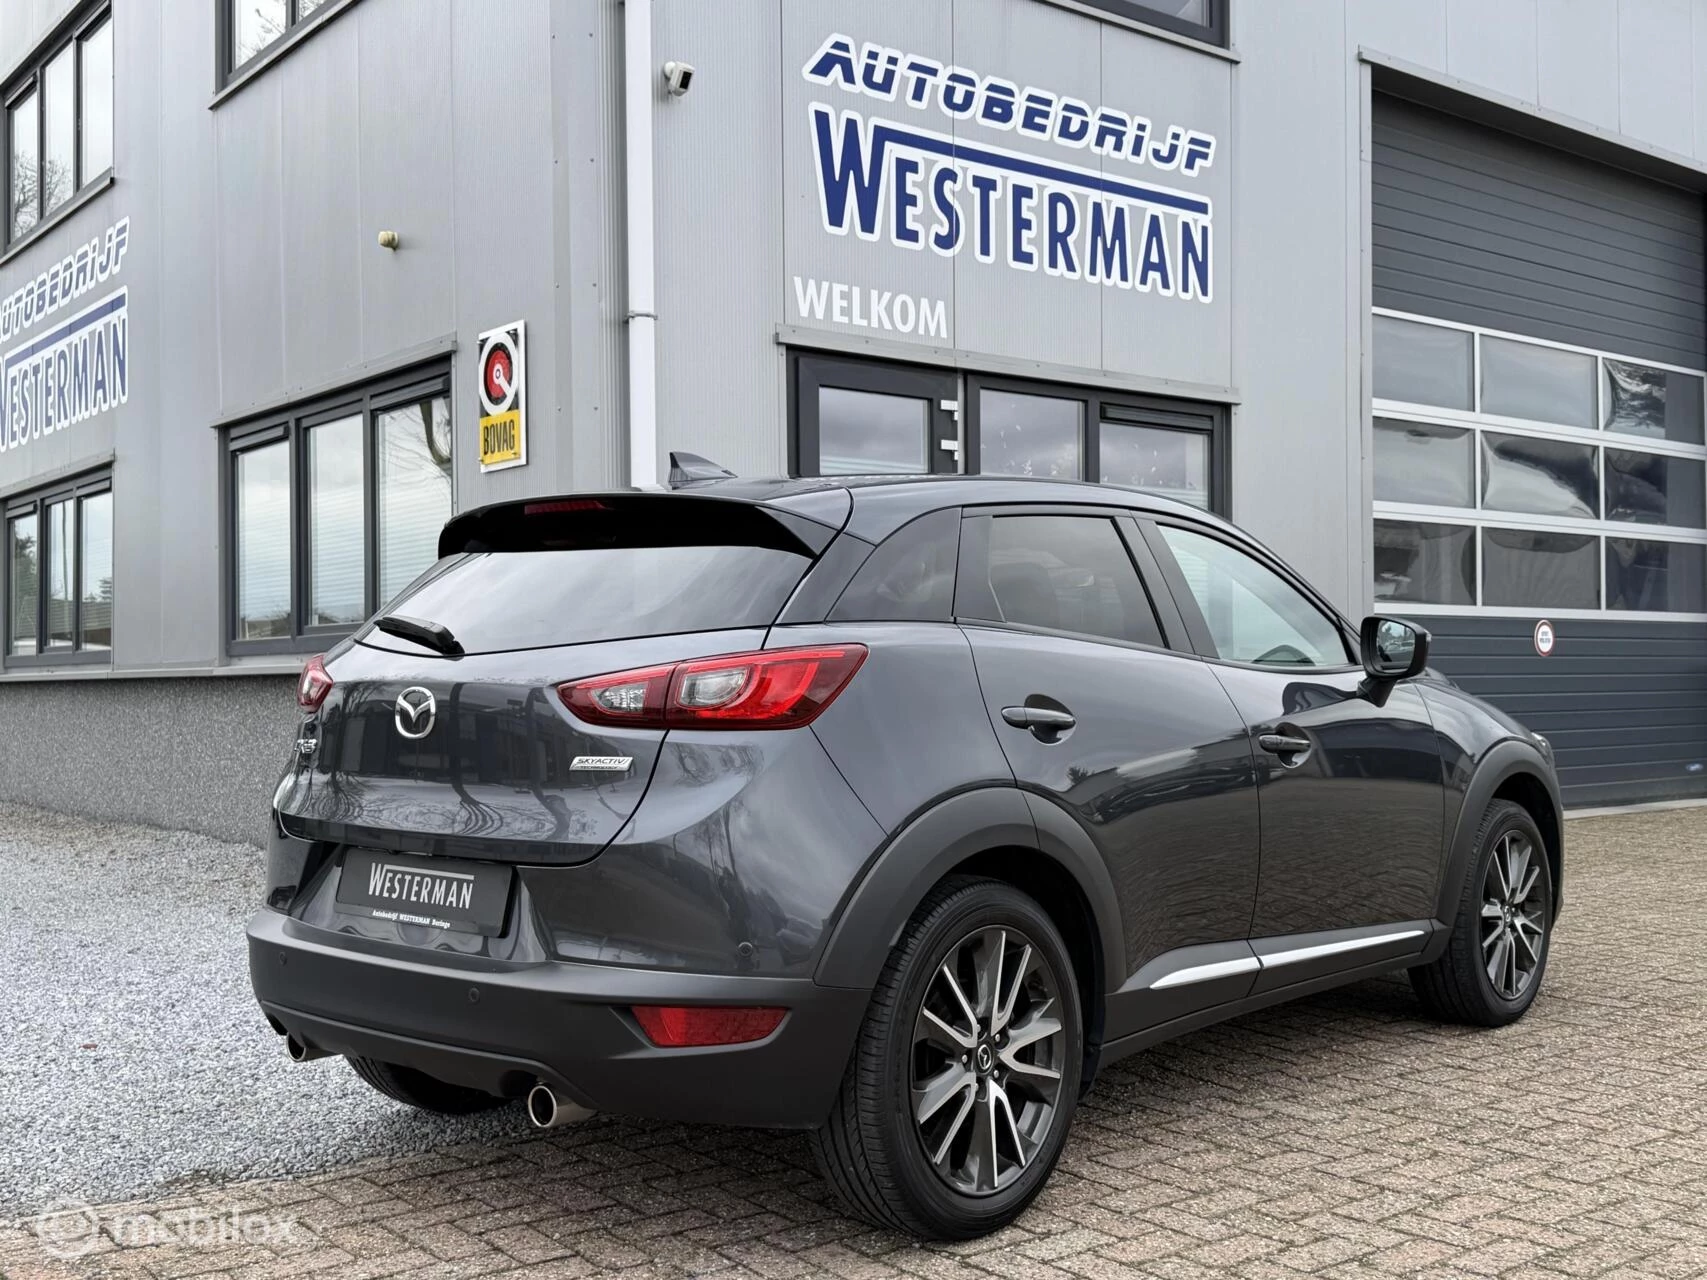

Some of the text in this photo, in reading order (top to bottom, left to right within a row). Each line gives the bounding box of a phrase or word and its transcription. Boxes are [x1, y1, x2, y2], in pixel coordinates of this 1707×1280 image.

[811, 106, 1210, 300] WESTERMAN
[0, 218, 128, 341] UTOBEDRIJF
[793, 275, 948, 340] WELKOM
[0, 290, 128, 450] ESTERMAN
[483, 419, 516, 456] BOVAG
[368, 862, 475, 910] WESTERMAN
[399, 912, 431, 925] WESTERMAN
